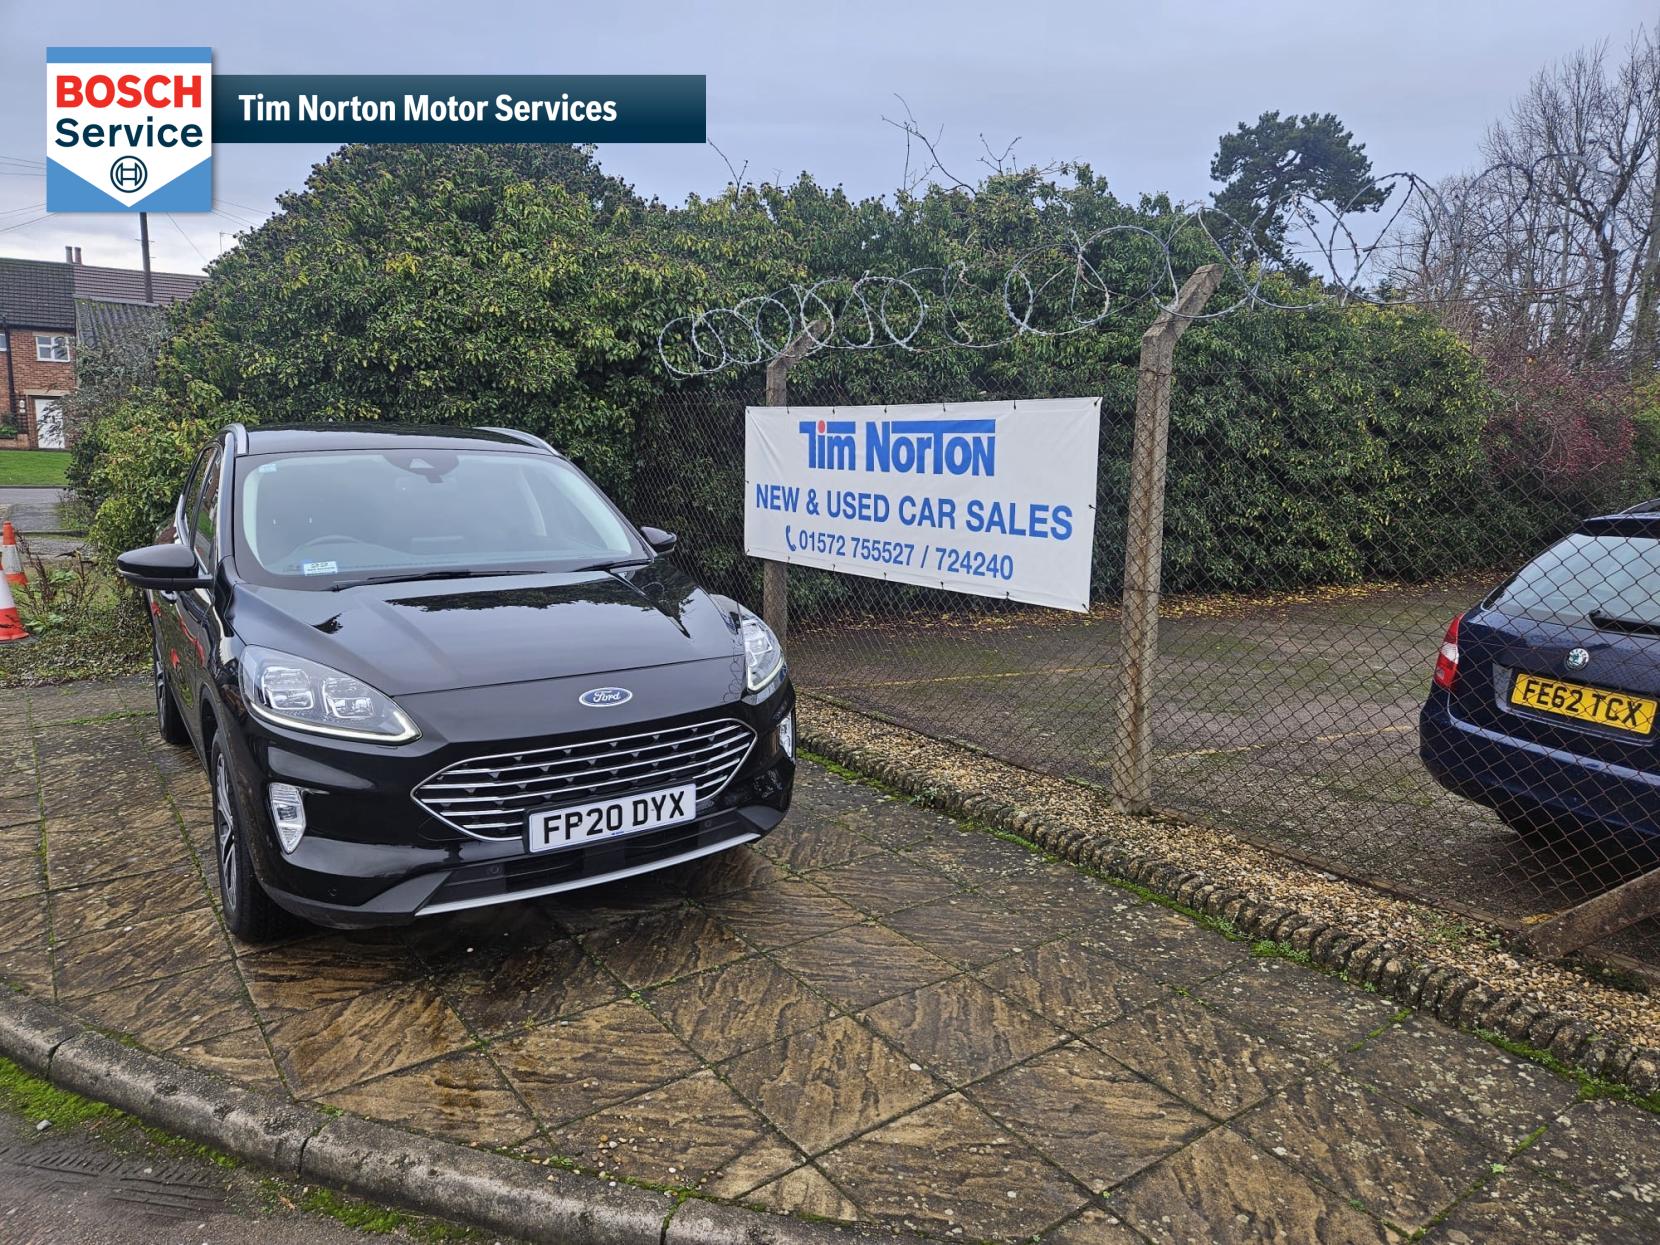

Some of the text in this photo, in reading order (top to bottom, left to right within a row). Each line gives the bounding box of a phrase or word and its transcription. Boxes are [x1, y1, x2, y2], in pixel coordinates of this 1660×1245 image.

[799, 420, 856, 471] Tim
[756, 484, 1073, 541] NEW & USED CAR SALES
[799, 530, 1014, 580] 01572 755527 / 724240
[593, 690, 620, 703] Ford
[1522, 680, 1584, 713] FE62
[543, 790, 686, 845] FP20 DYX
